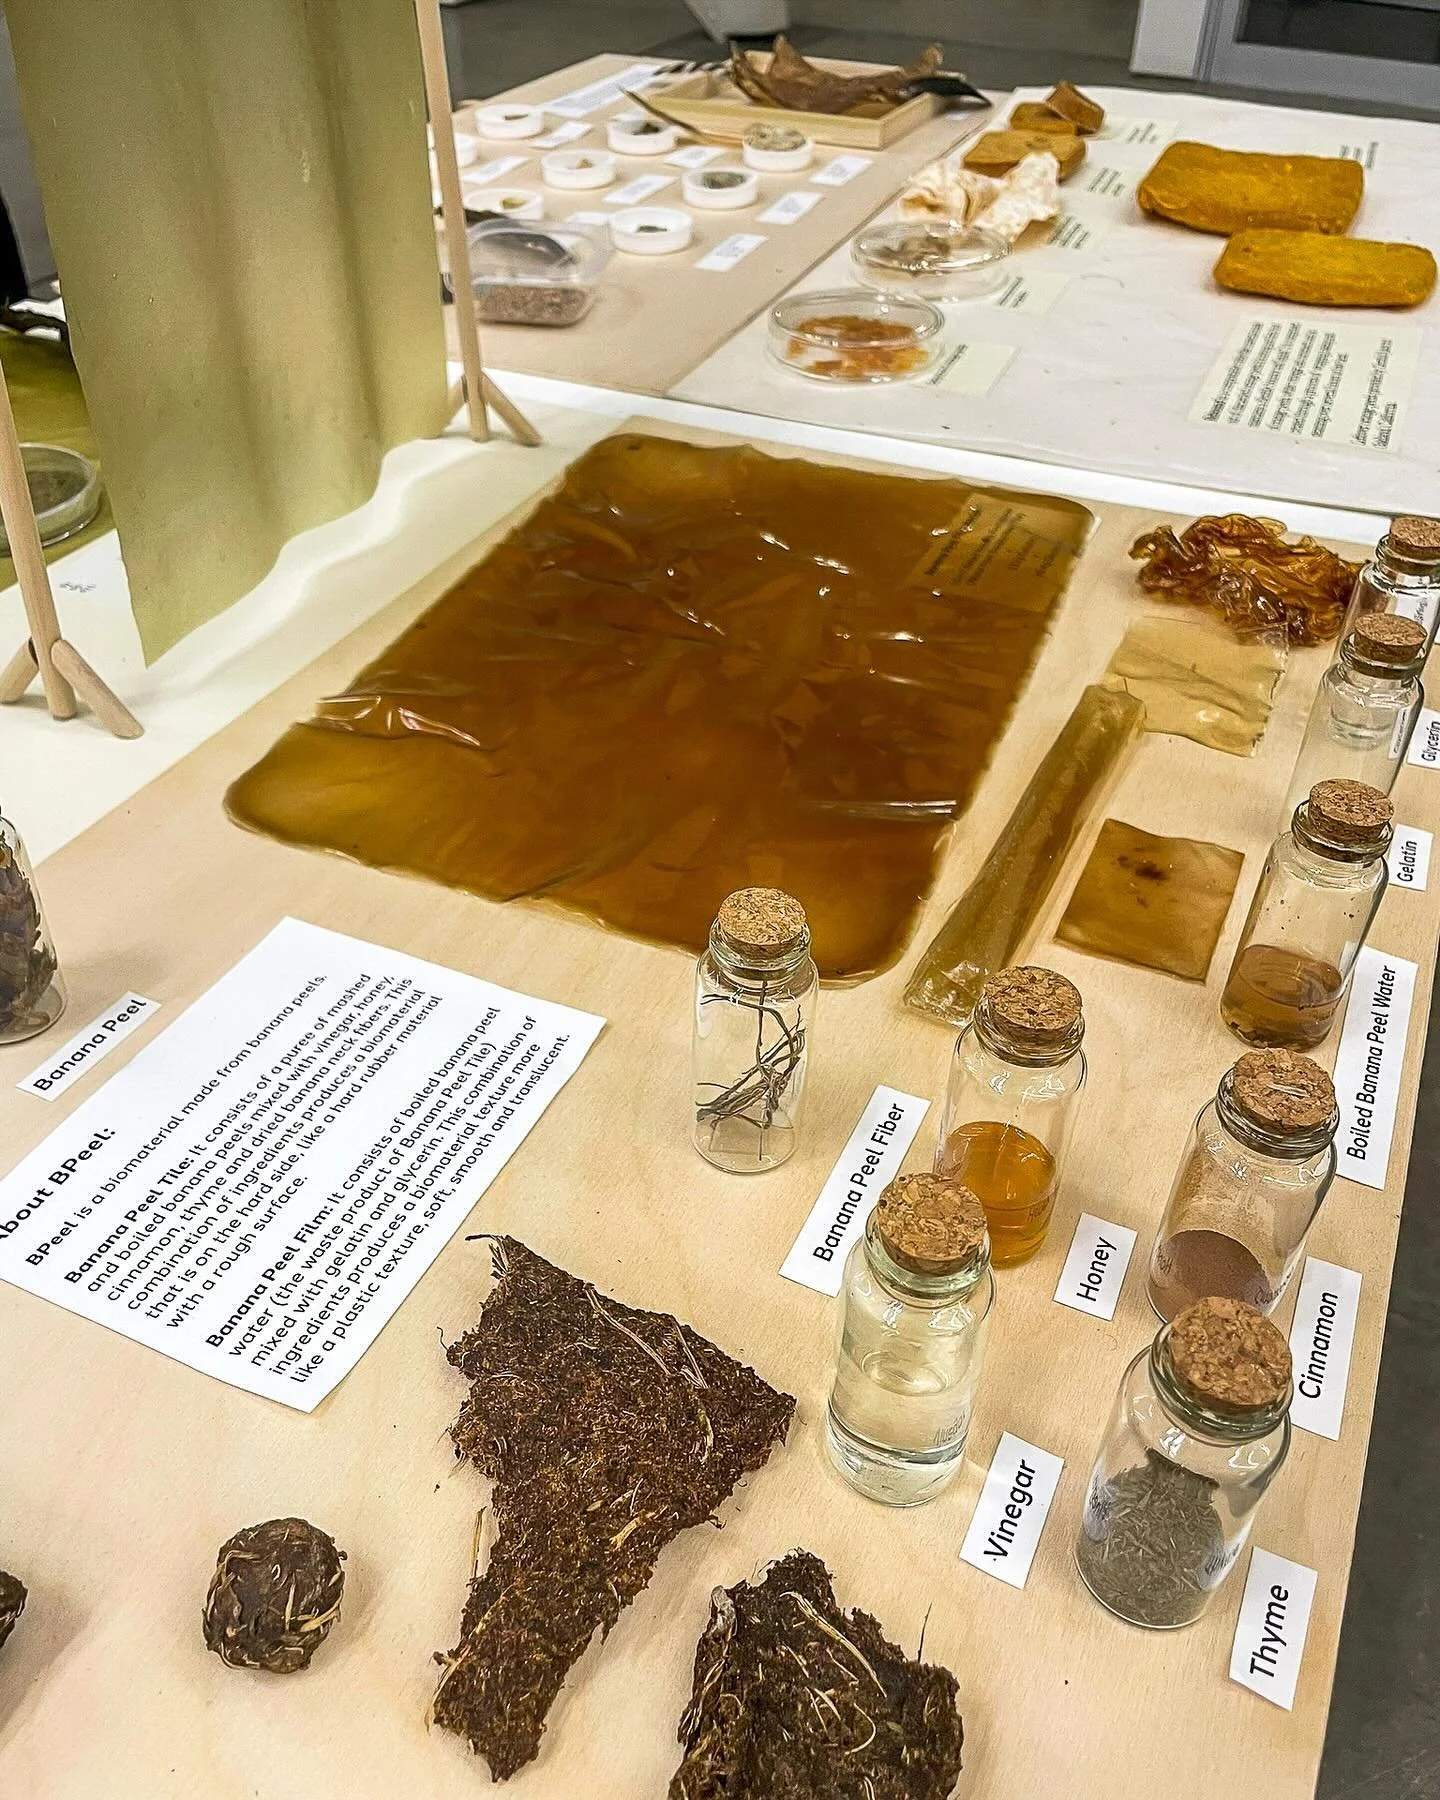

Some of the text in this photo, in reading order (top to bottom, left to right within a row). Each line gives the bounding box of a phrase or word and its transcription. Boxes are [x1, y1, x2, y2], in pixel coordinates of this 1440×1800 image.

[1421, 721, 1440, 762] Glycerin
[1396, 840, 1418, 882] Gelatin
[24, 1220, 78, 1266] BPeel
[72, 1205, 92, 1219] is
[90, 1193, 105, 1204] a
[99, 1115, 184, 1192] biomaterial
[180, 1079, 220, 1114] made
[215, 1048, 251, 1077] from
[244, 1005, 294, 1048] banana
[32, 999, 147, 1091] Banana Peel
[63, 973, 371, 1284] Banana Peel Tile: It consists of a puree of mashed
[87, 1260, 120, 1292] and
[113, 1212, 166, 1260] boiled
[159, 1159, 217, 1212] banana
[214, 1122, 253, 1160] peels
[249, 1081, 290, 1121] mixed
[285, 1055, 317, 1080] with
[312, 1012, 361, 1053] vinegar,
[106, 1225, 186, 1301] cinnamon,
[178, 1176, 227, 1221] thyme
[224, 1146, 254, 1174] and
[251, 1112, 286, 1147] dried
[280, 1066, 330, 1112] banana
[327, 1036, 358, 1065] neck
[383, 978, 412, 999] This
[127, 988, 426, 1310] combination of ingredients produces a biomaterial
[144, 995, 443, 1318] that is on the hard side, like a hard rubber material
[1346, 965, 1396, 1161] Boiled Banana Peel Water
[0, 1127, 116, 1239] bout BPeel:
[165, 1176, 308, 1327] with a rough surface.
[204, 1006, 501, 1348] Banana Peel Film: It consists of boiled banana peel
[227, 1042, 497, 1355] water (the waste product of Banana Peel Tile)
[250, 1014, 536, 1366] mixed with gelatin and glycerin. This combination of
[268, 1043, 540, 1375] ingredients produces a biomaterial texture more
[289, 1354, 324, 1382] like
[321, 1339, 336, 1351] a
[331, 1281, 380, 1339] plastic
[373, 1222, 429, 1279] texture,
[422, 1187, 456, 1219] soft,
[449, 1133, 495, 1184] smooth
[490, 1105, 515, 1131] and
[812, 1103, 905, 1262] Banana Peel Fiber
[1076, 1236, 1117, 1302] Honey
[1298, 1292, 1339, 1399] Cinnamon
[983, 1458, 1036, 1557] Vinegar
[1249, 1584, 1289, 1678] Thyme
